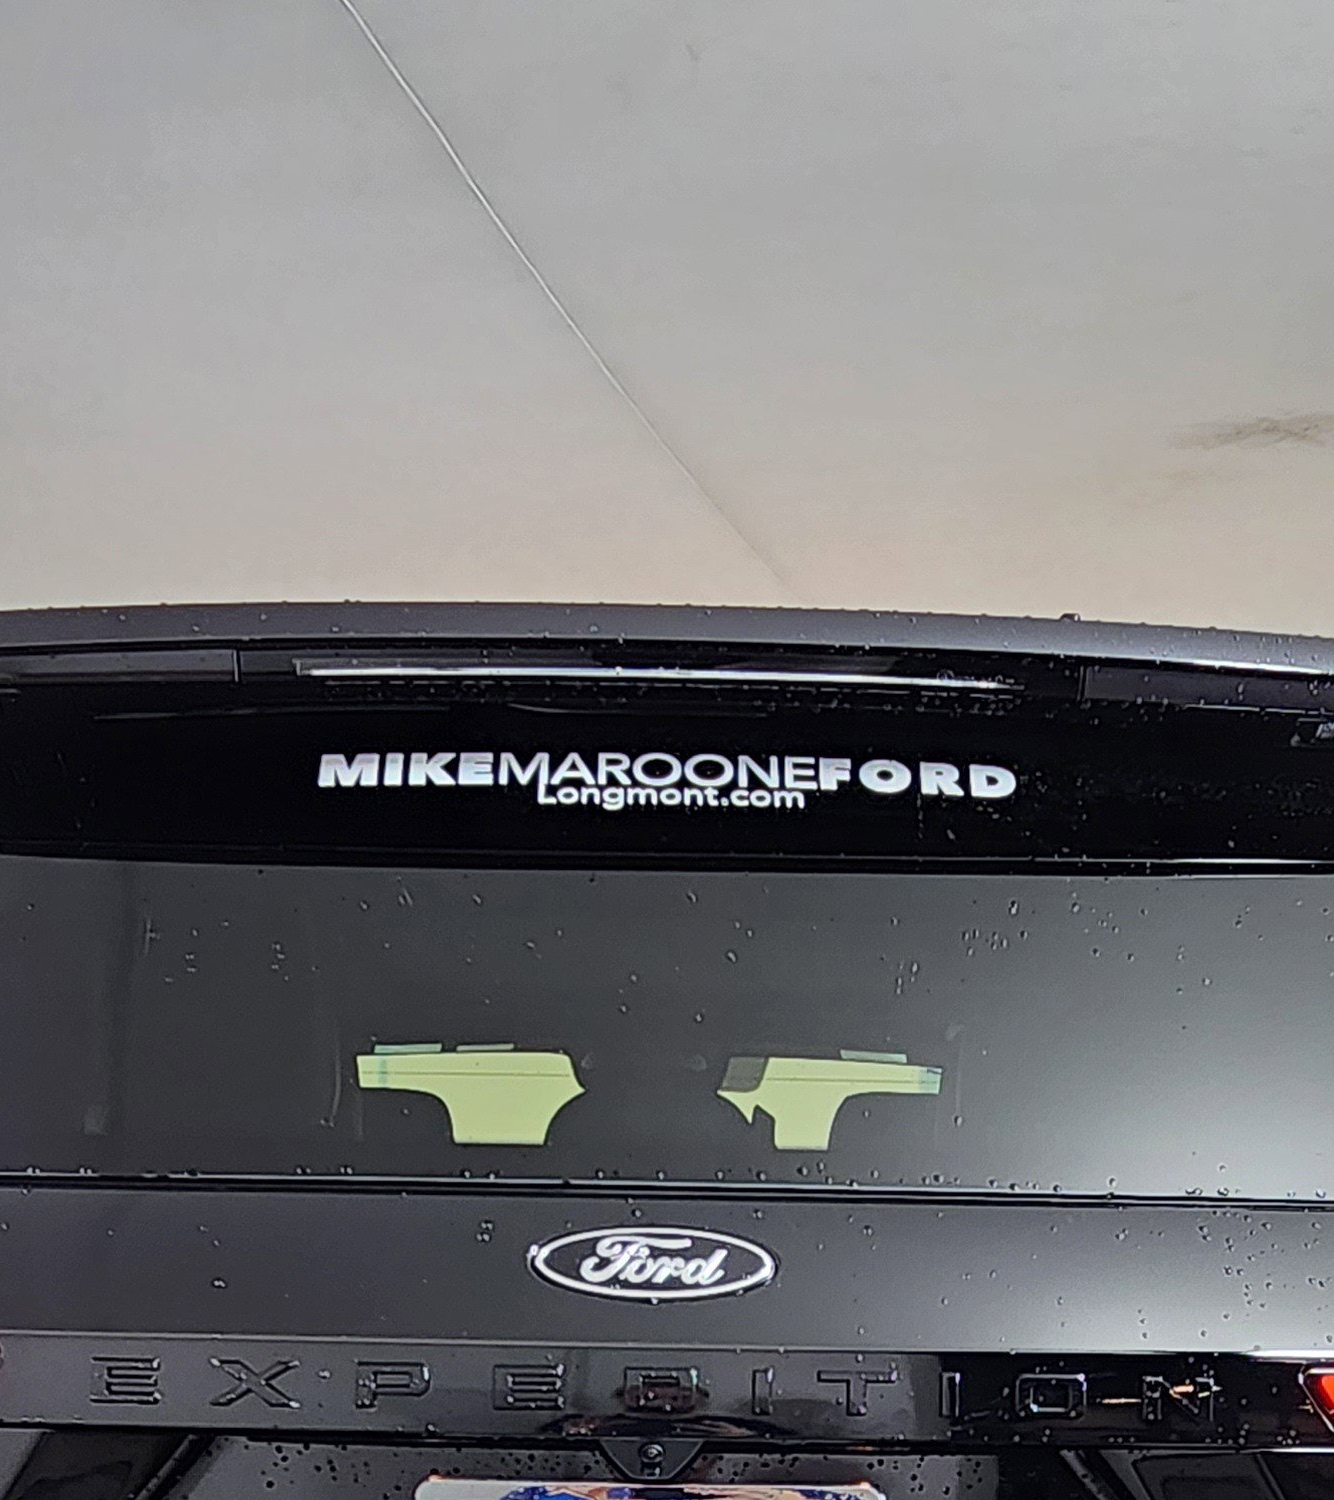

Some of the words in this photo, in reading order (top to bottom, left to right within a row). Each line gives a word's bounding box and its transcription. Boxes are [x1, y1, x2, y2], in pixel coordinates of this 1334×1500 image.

[537, 782, 806, 812] Longmont.com
[579, 1234, 726, 1287] Ford
[89, 1356, 1214, 1421] EXPEDITION
